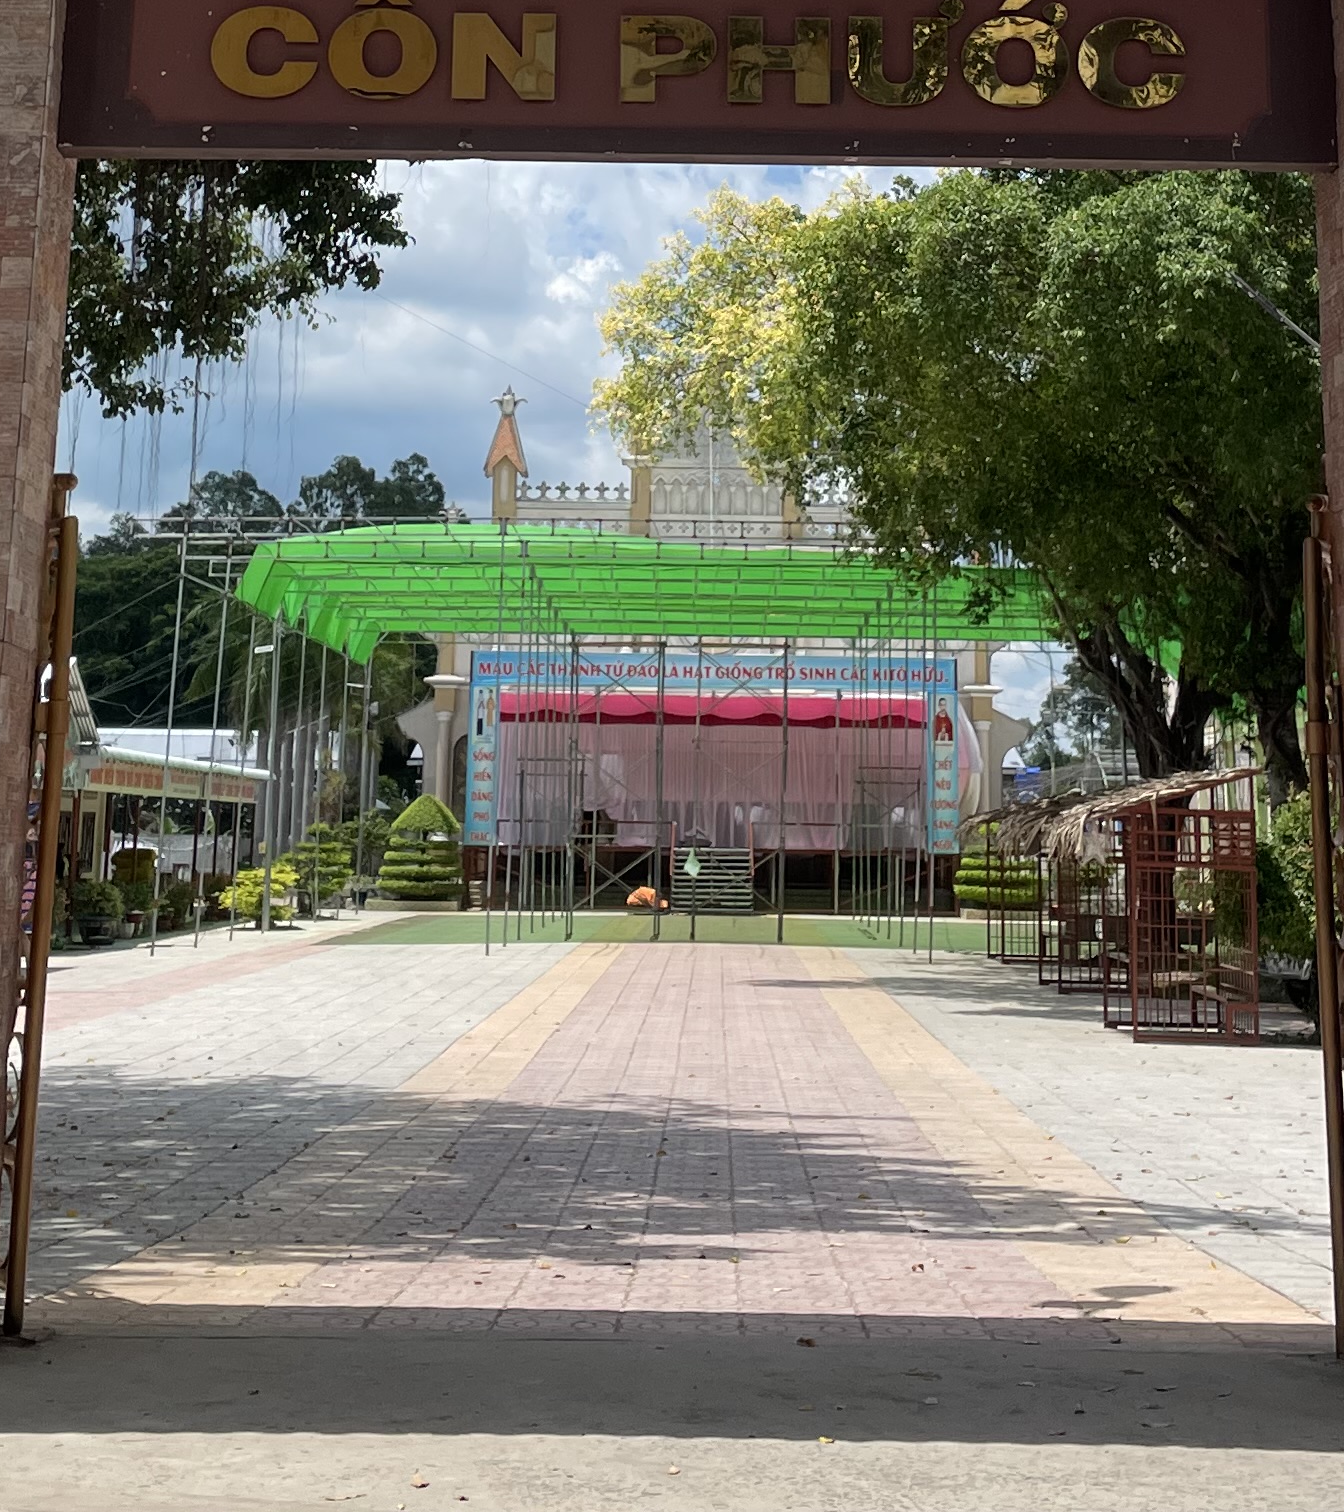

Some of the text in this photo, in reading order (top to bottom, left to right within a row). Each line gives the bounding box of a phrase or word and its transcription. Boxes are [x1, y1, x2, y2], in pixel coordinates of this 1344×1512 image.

[517, 658, 545, 676] CÁC
[716, 660, 763, 679] GIỐNG
[800, 666, 836, 680] SINH
[840, 664, 868, 681] CÁC
